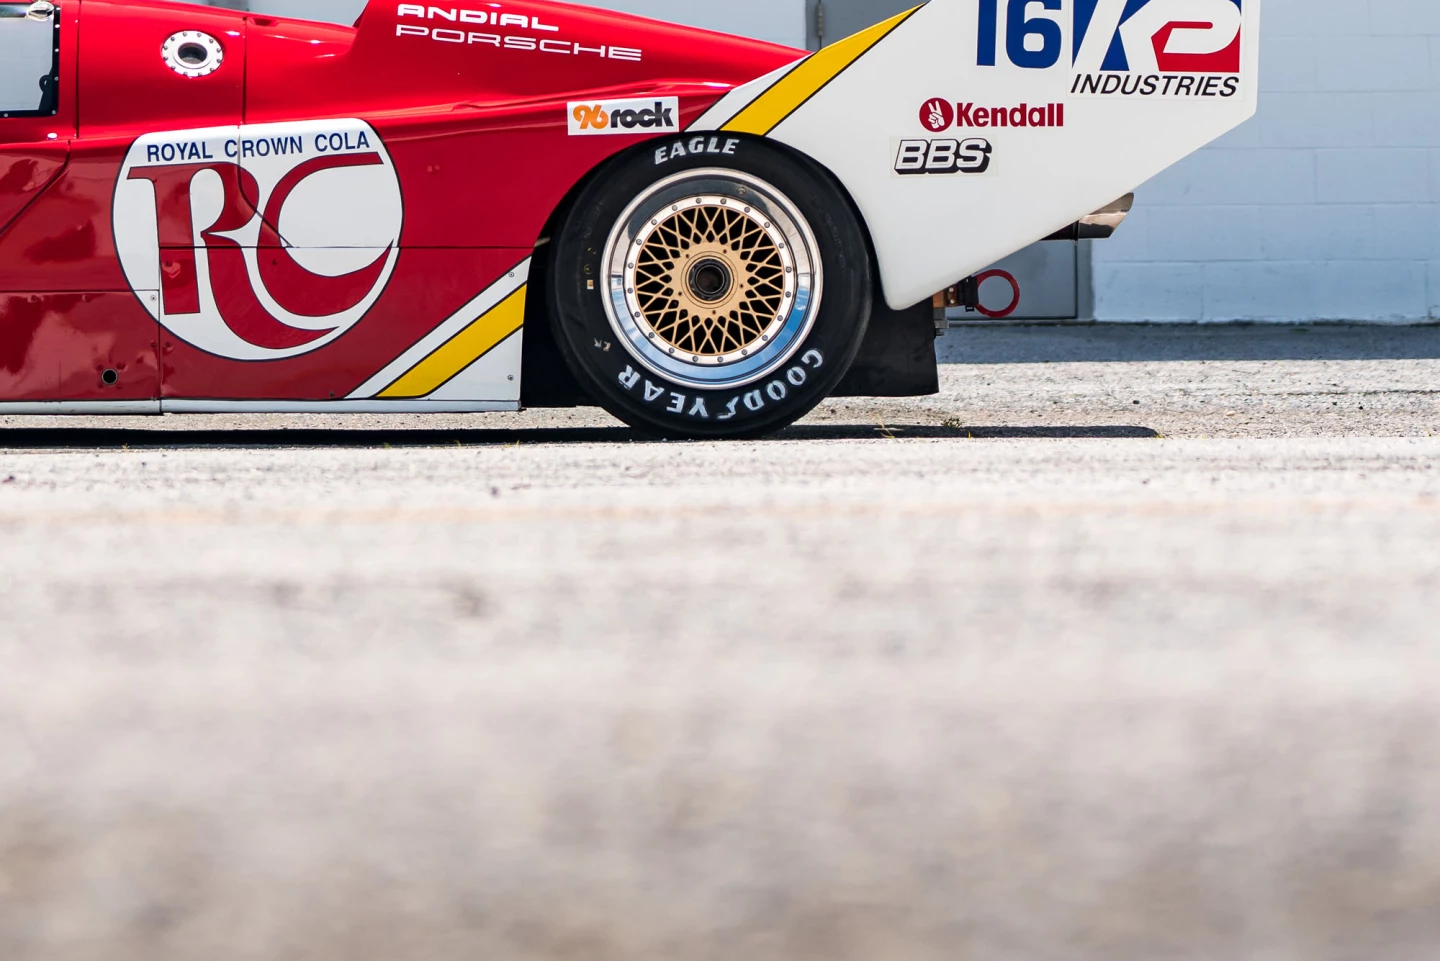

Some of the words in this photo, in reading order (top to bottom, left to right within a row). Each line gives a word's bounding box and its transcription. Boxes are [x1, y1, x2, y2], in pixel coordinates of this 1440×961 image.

[397, 3, 559, 32] ANDIAL
[396, 24, 642, 61] PORSCHE
[1070, 73, 1240, 97] INDUSTRIES
[573, 104, 609, 129] 96
[610, 101, 674, 129] rock
[956, 102, 1064, 128] Kendall
[146, 141, 213, 162] ROYAL
[224, 136, 303, 158] CROWN
[314, 130, 370, 152] COLA
[654, 136, 740, 165] EAGLE
[894, 138, 992, 175] BBS
[126, 151, 394, 350] RC
[617, 348, 824, 420] GOODYEAR
